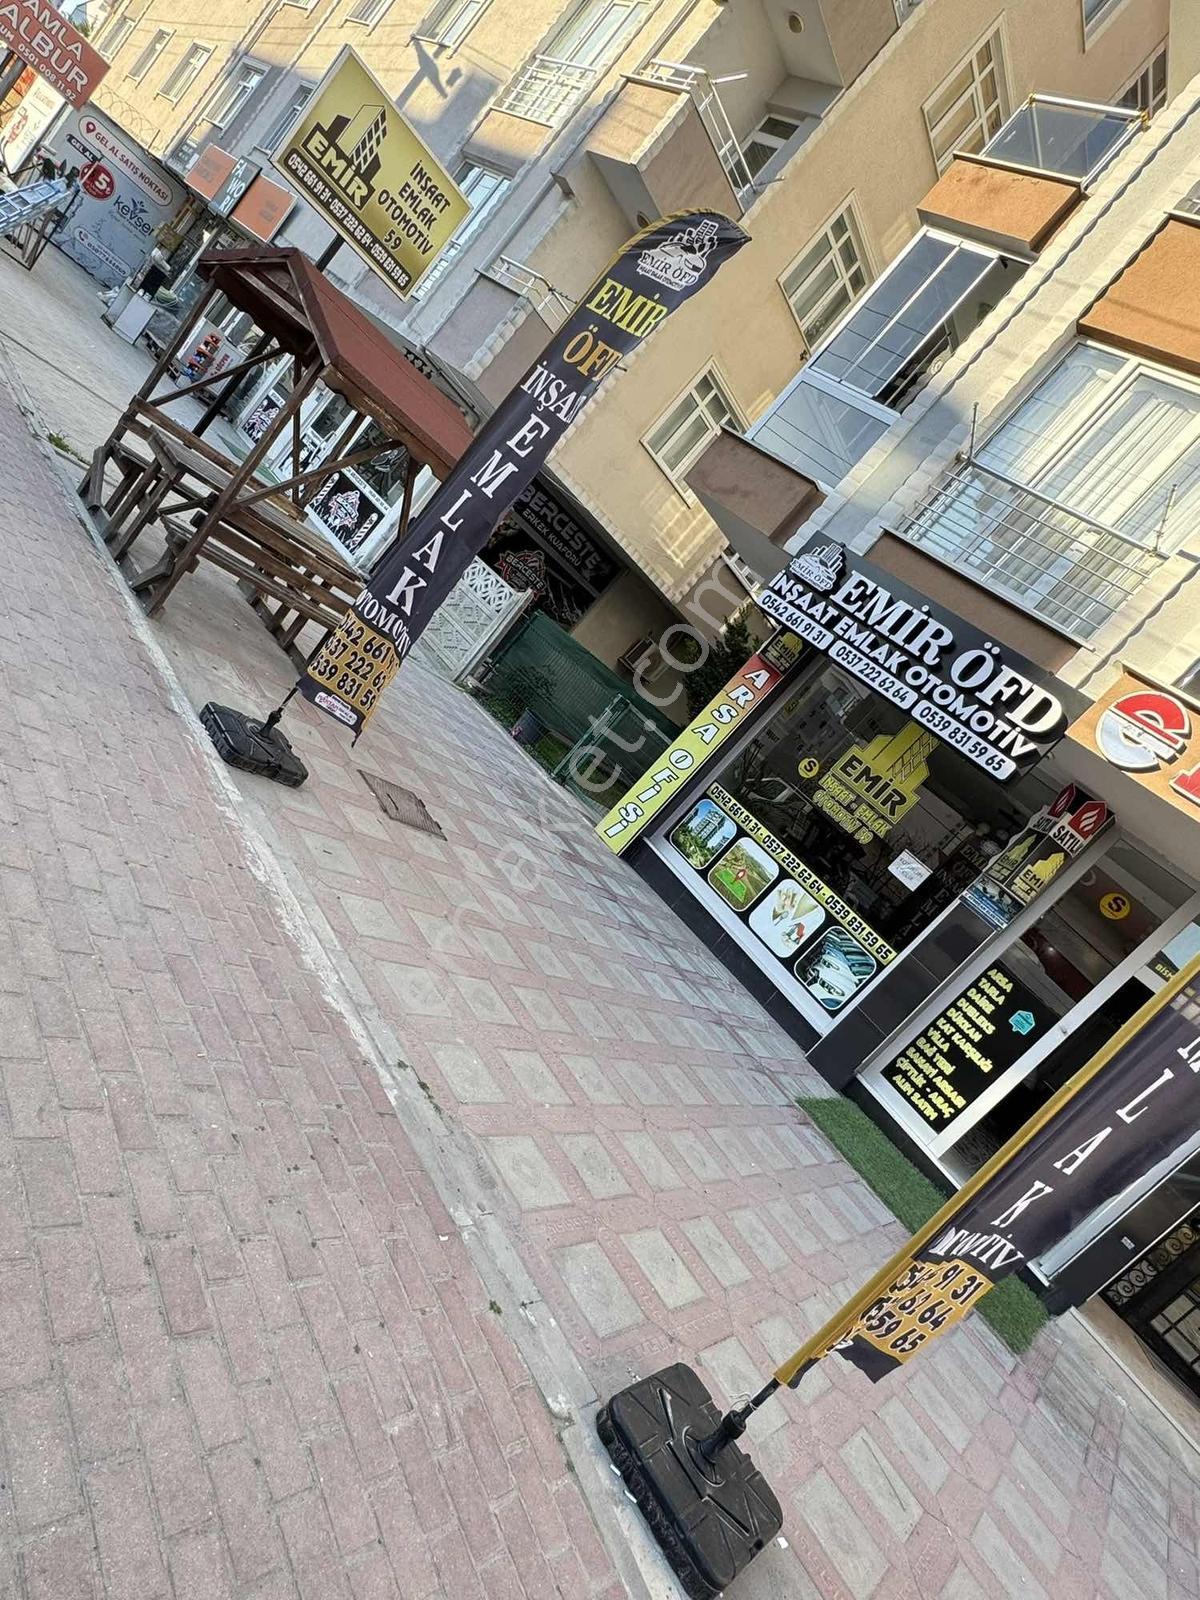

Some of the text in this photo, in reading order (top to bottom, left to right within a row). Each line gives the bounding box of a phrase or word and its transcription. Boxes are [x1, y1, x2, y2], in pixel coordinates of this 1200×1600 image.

[95, 132, 109, 148] GEL
[108, 146, 119, 158] AL
[307, 132, 370, 209] EMİR
[409, 160, 451, 214] İNŞAAT
[286, 154, 309, 176] 0542
[302, 171, 318, 187] 661
[312, 182, 324, 194] 91
[328, 199, 347, 218] 0537
[342, 214, 358, 230] 222
[352, 225, 365, 238] 62
[369, 244, 387, 262] 0539
[378, 189, 434, 256] OTOMOTİV
[383, 230, 403, 251] 59
[522, 509, 548, 537] ERKEK
[761, 594, 825, 645] 0542 661 91 31
[345, 651, 374, 681] 222
[363, 636, 392, 664] 661
[768, 571, 840, 625] İNŞAAT
[832, 620, 910, 677] EMLAK
[904, 666, 1038, 760] OTOMOTİV
[829, 570, 1065, 733] EMİR ÖFD
[336, 672, 362, 700] 831
[835, 645, 909, 705] 0537 222 62 64
[693, 668, 772, 746] ARSA
[918, 706, 1007, 773] 0539 831 59 65
[839, 754, 907, 817] EMİR
[710, 786, 892, 961] 0542 661 91 31 0537 222 62 64 0539 831 59 65
[978, 977, 1006, 1005] TARLA
[987, 968, 1013, 993] ARSA
[927, 1026, 950, 1053] VİLLA
[936, 1017, 956, 1035] KAT
[949, 1273, 983, 1305] 31
[917, 1299, 953, 1332] 64
[889, 1325, 929, 1354] 65
